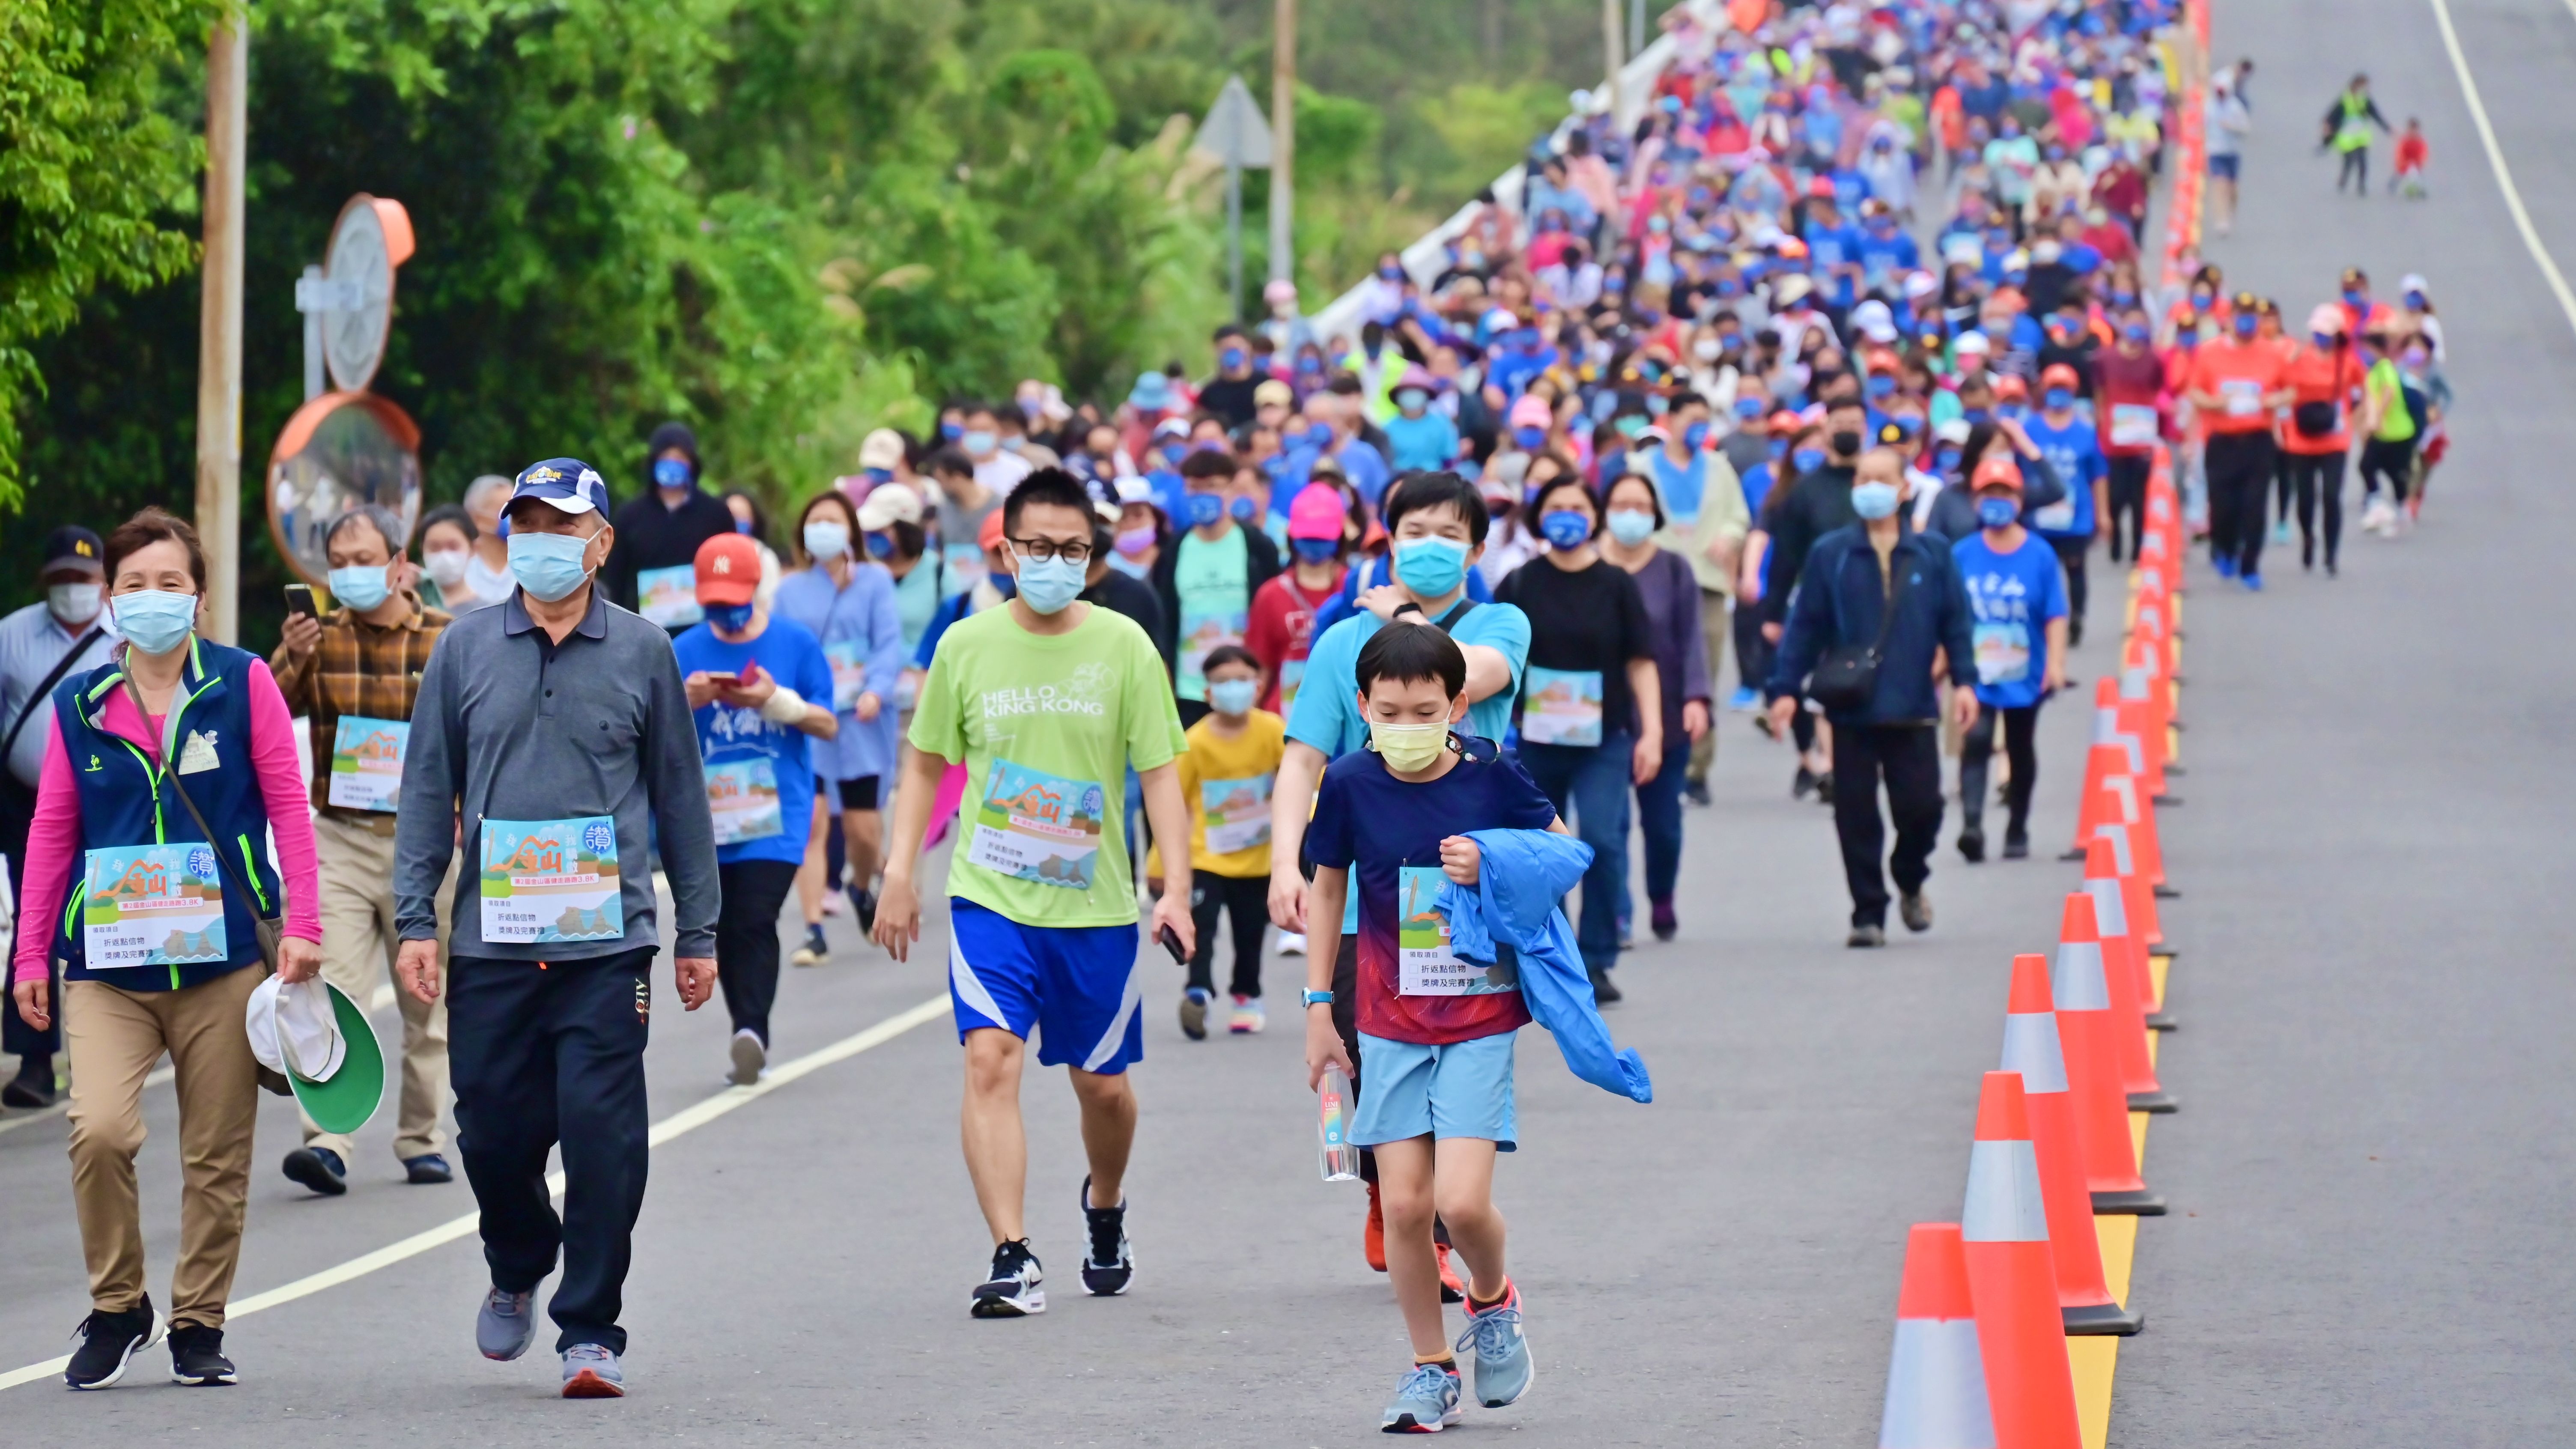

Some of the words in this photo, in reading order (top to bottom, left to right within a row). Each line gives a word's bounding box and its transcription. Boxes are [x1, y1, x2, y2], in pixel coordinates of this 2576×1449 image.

[982, 685, 1055, 705] HELLO
[984, 700, 1036, 719] KING
[1041, 698, 1103, 715] KONG
[585, 826, 611, 850] 讚
[190, 851, 214, 875] 讚
[498, 913, 536, 922] 折返點信物
[104, 937, 144, 947] 折返點信物
[1421, 965, 1466, 973] 折返點信物
